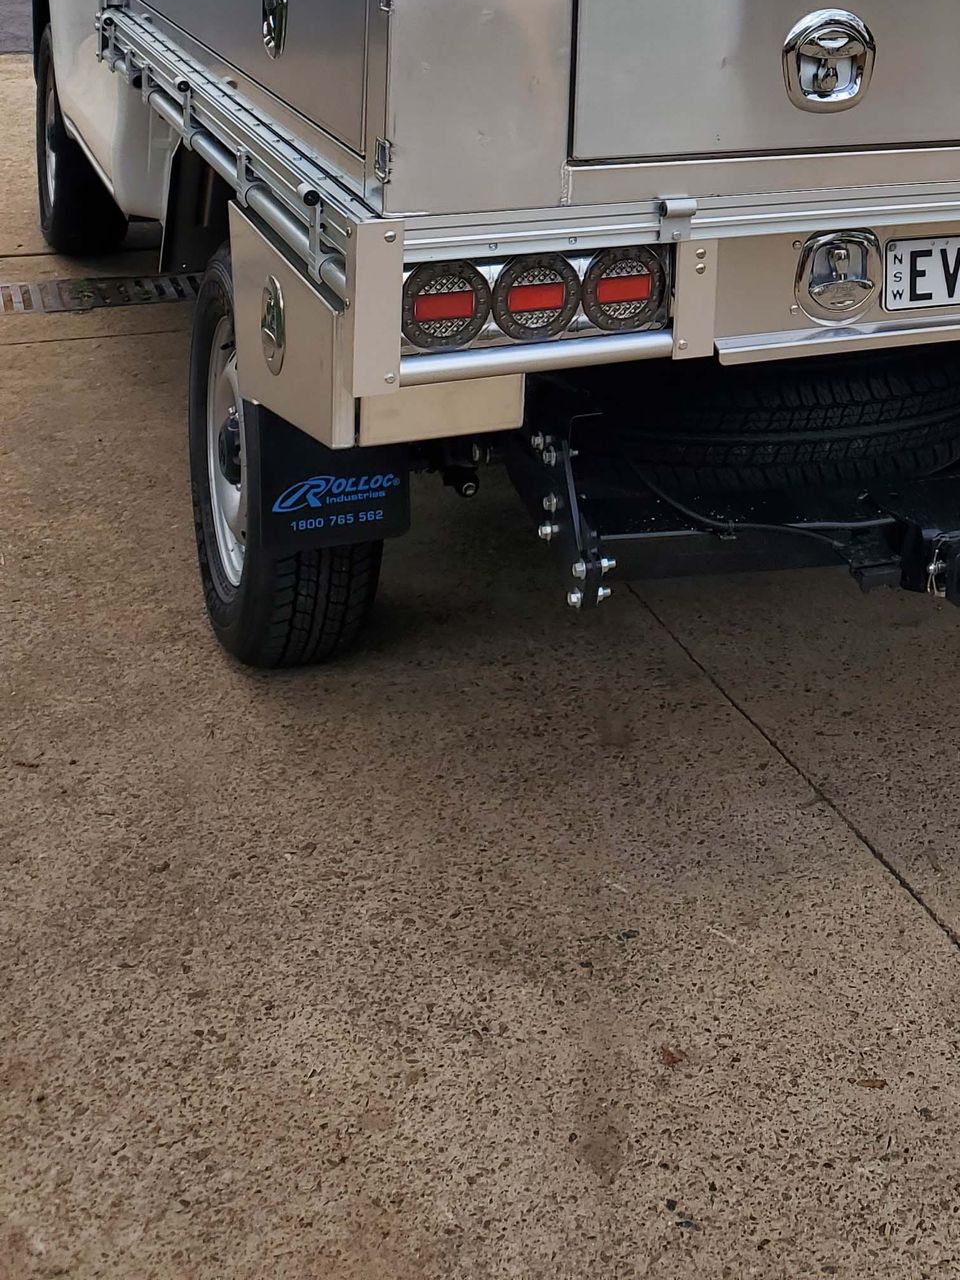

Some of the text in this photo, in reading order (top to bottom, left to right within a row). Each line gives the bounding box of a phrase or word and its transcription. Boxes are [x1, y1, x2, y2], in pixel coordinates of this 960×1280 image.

[272, 473, 394, 512] ROLLOC
[326, 490, 386, 504] Industries
[290, 510, 383, 531] 1800 765 562
